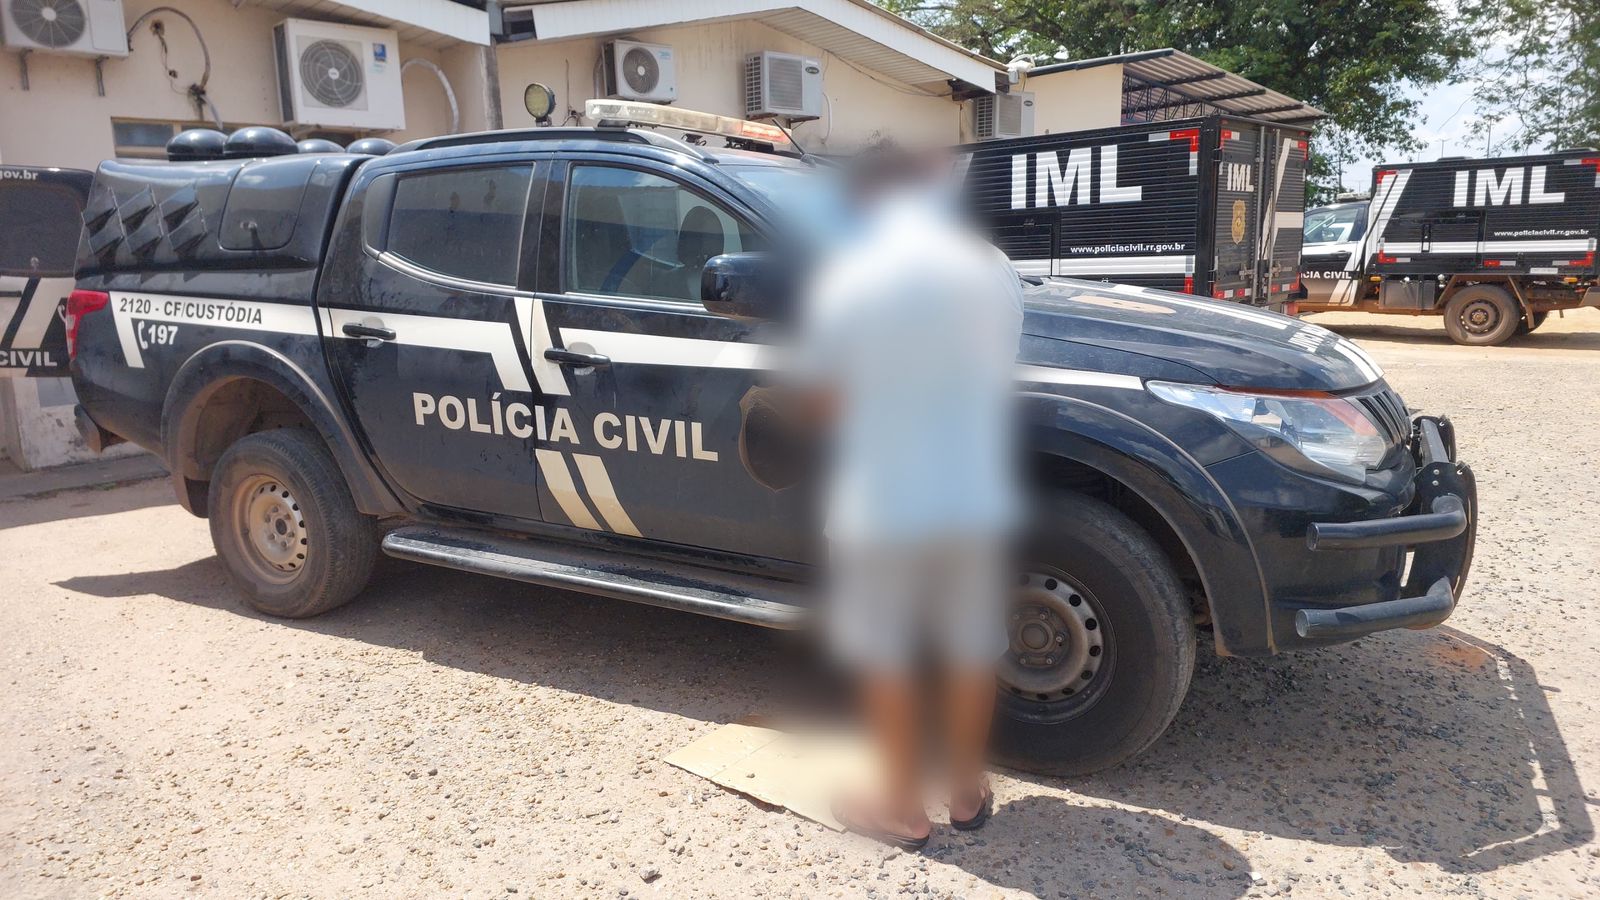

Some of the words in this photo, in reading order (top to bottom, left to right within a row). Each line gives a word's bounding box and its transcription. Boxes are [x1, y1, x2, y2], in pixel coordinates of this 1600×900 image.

[1011, 144, 1143, 210] IML
[1226, 162, 1255, 192] IML
[1453, 165, 1566, 208] IML
[1493, 229, 1589, 237] www.policiacivil.rr.gov.br
[1070, 242, 1186, 255] www.policiacivil.rr.gov.br
[1323, 271, 1352, 279] CIVIL
[119, 297, 151, 314] 2120
[163, 301, 263, 325] CF/CUSTÓDIA
[147, 324, 179, 346] 197
[412, 391, 581, 445] POLÍCIA
[592, 412, 719, 462] CIVIL
